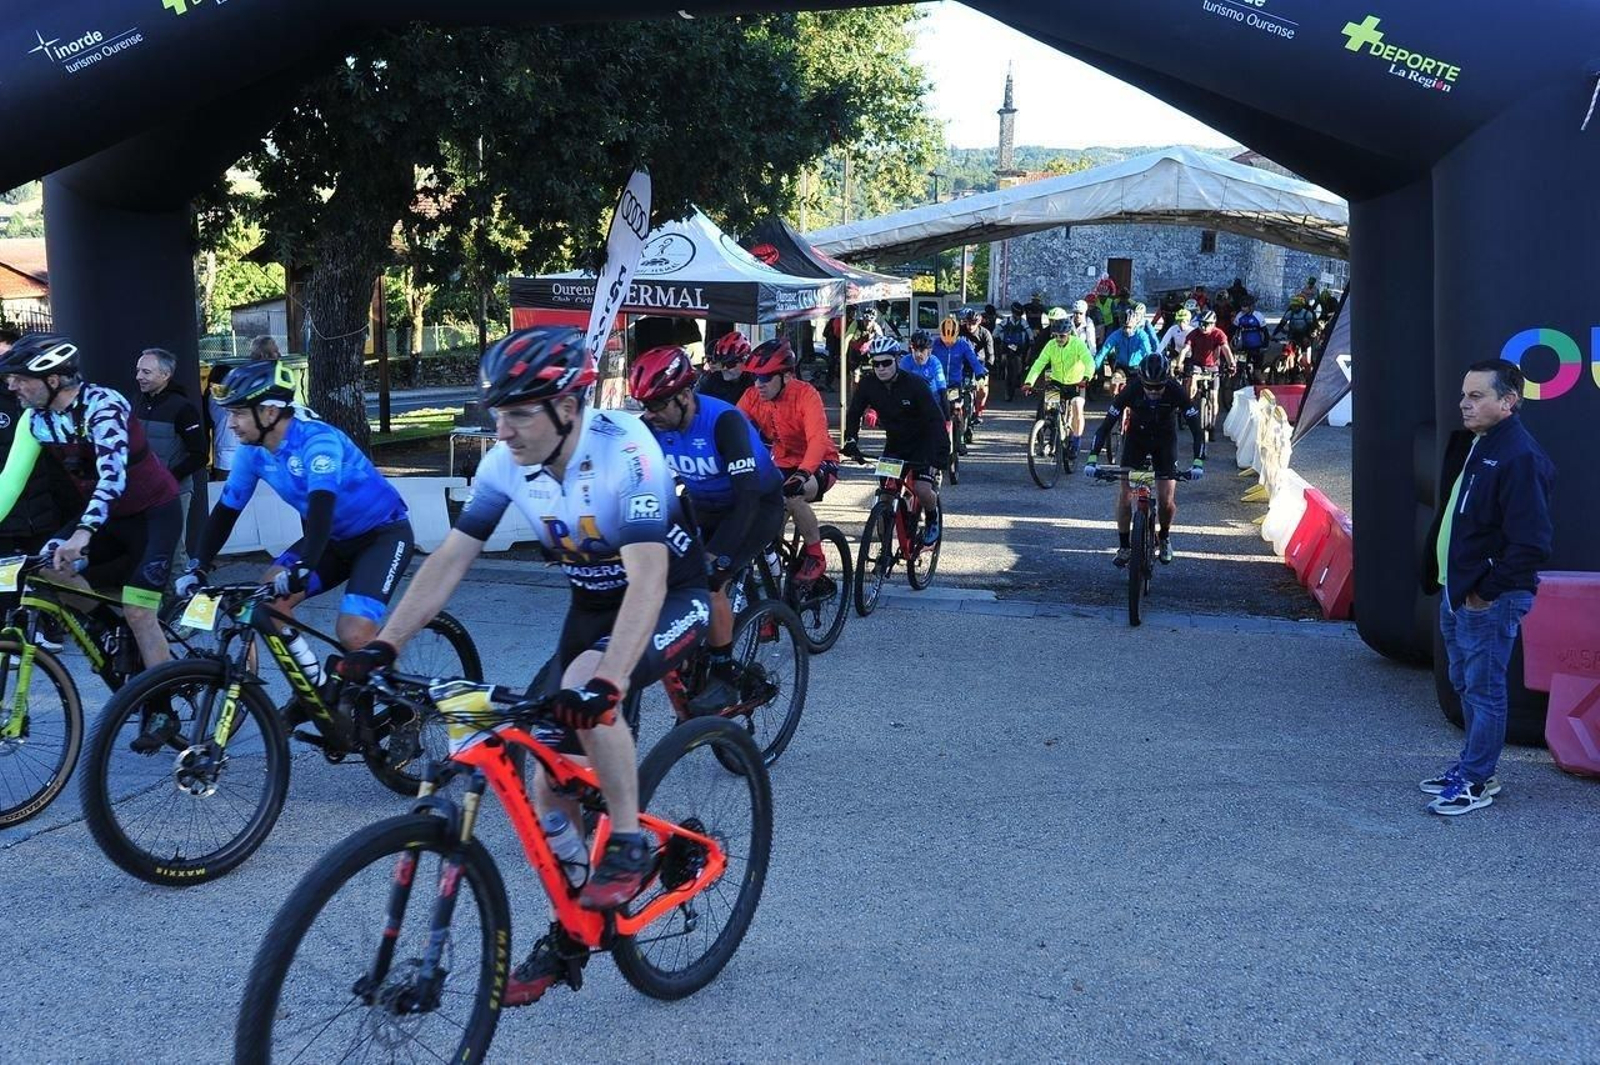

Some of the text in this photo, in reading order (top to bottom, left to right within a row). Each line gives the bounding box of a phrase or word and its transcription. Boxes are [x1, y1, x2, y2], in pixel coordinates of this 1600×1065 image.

[1203, 0, 1295, 39] turismo Ourense
[54, 30, 103, 60] inorde
[65, 33, 144, 74] turismo Ourense
[1369, 41, 1461, 82] DEPORTE
[1388, 63, 1406, 77] La
[727, 457, 756, 473] ADN
[155, 866, 206, 878] MAXXIS
[489, 929, 508, 1011] MAXXIS
